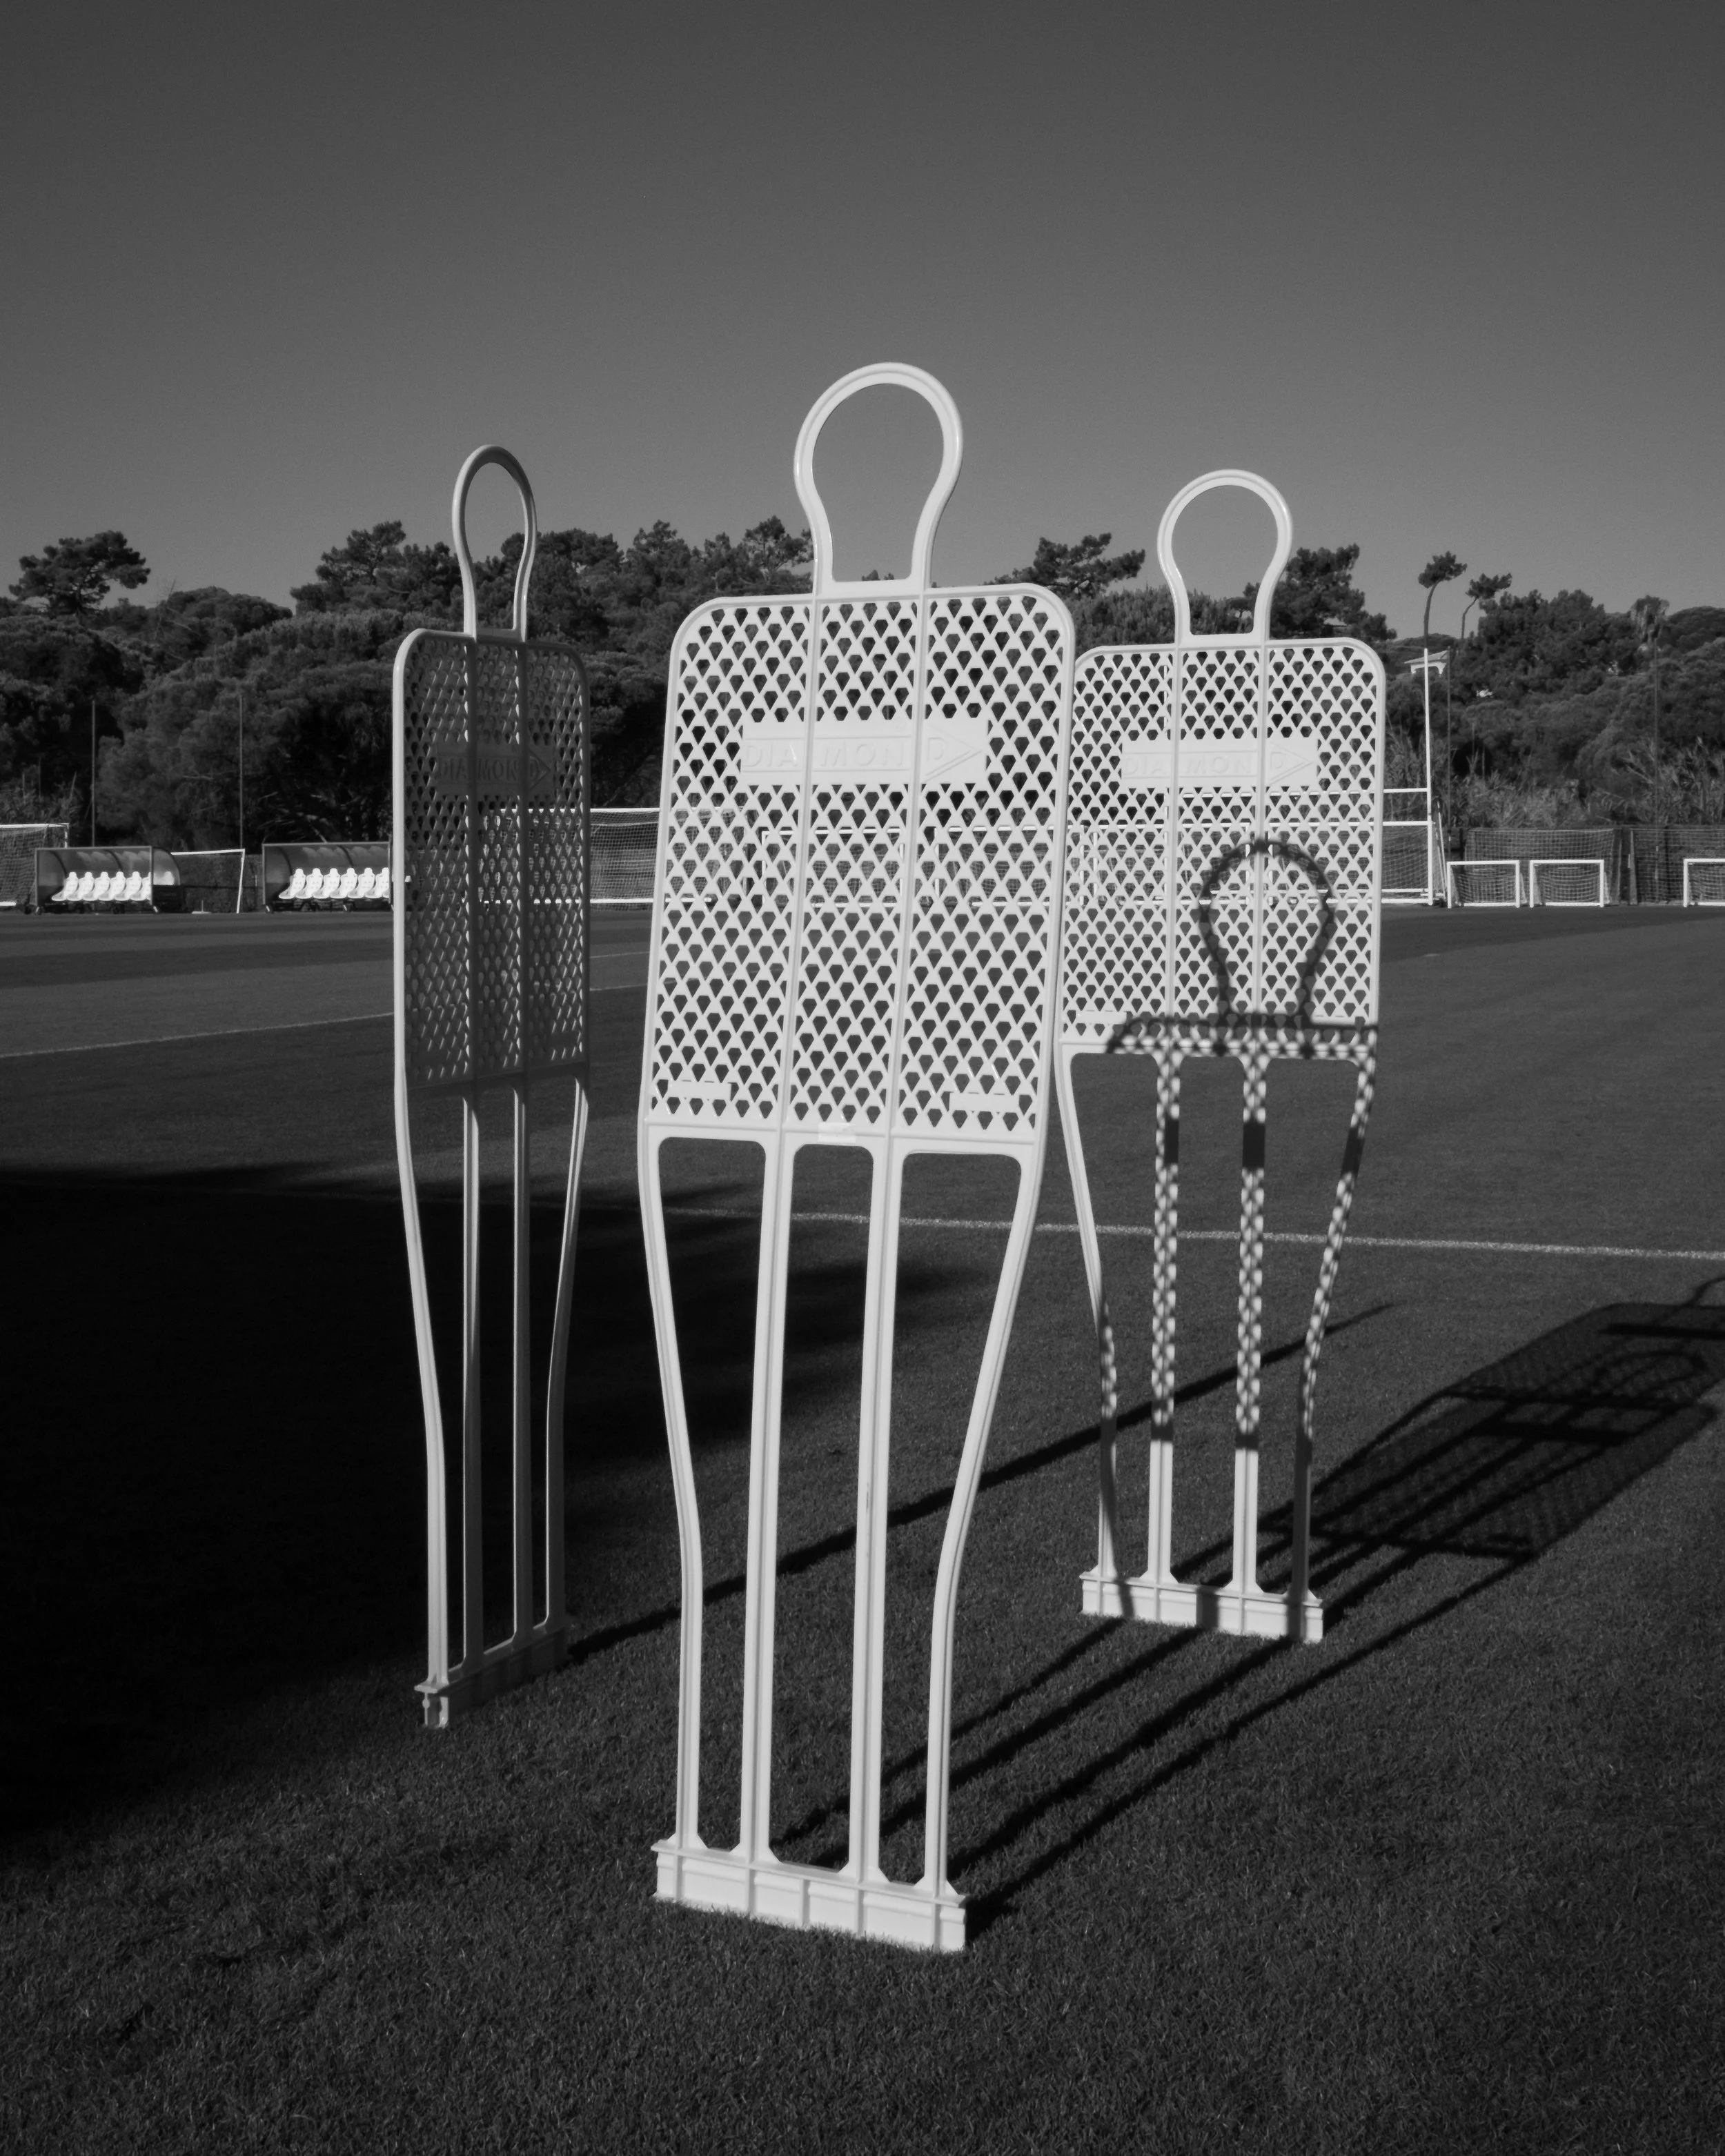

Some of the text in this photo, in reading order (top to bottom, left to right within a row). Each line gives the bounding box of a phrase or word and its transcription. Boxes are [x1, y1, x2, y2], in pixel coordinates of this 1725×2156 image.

[744, 736, 946, 767] DIAMOND
[1123, 751, 1286, 775] DIAMOND
[440, 756, 540, 781] DIAMOND
